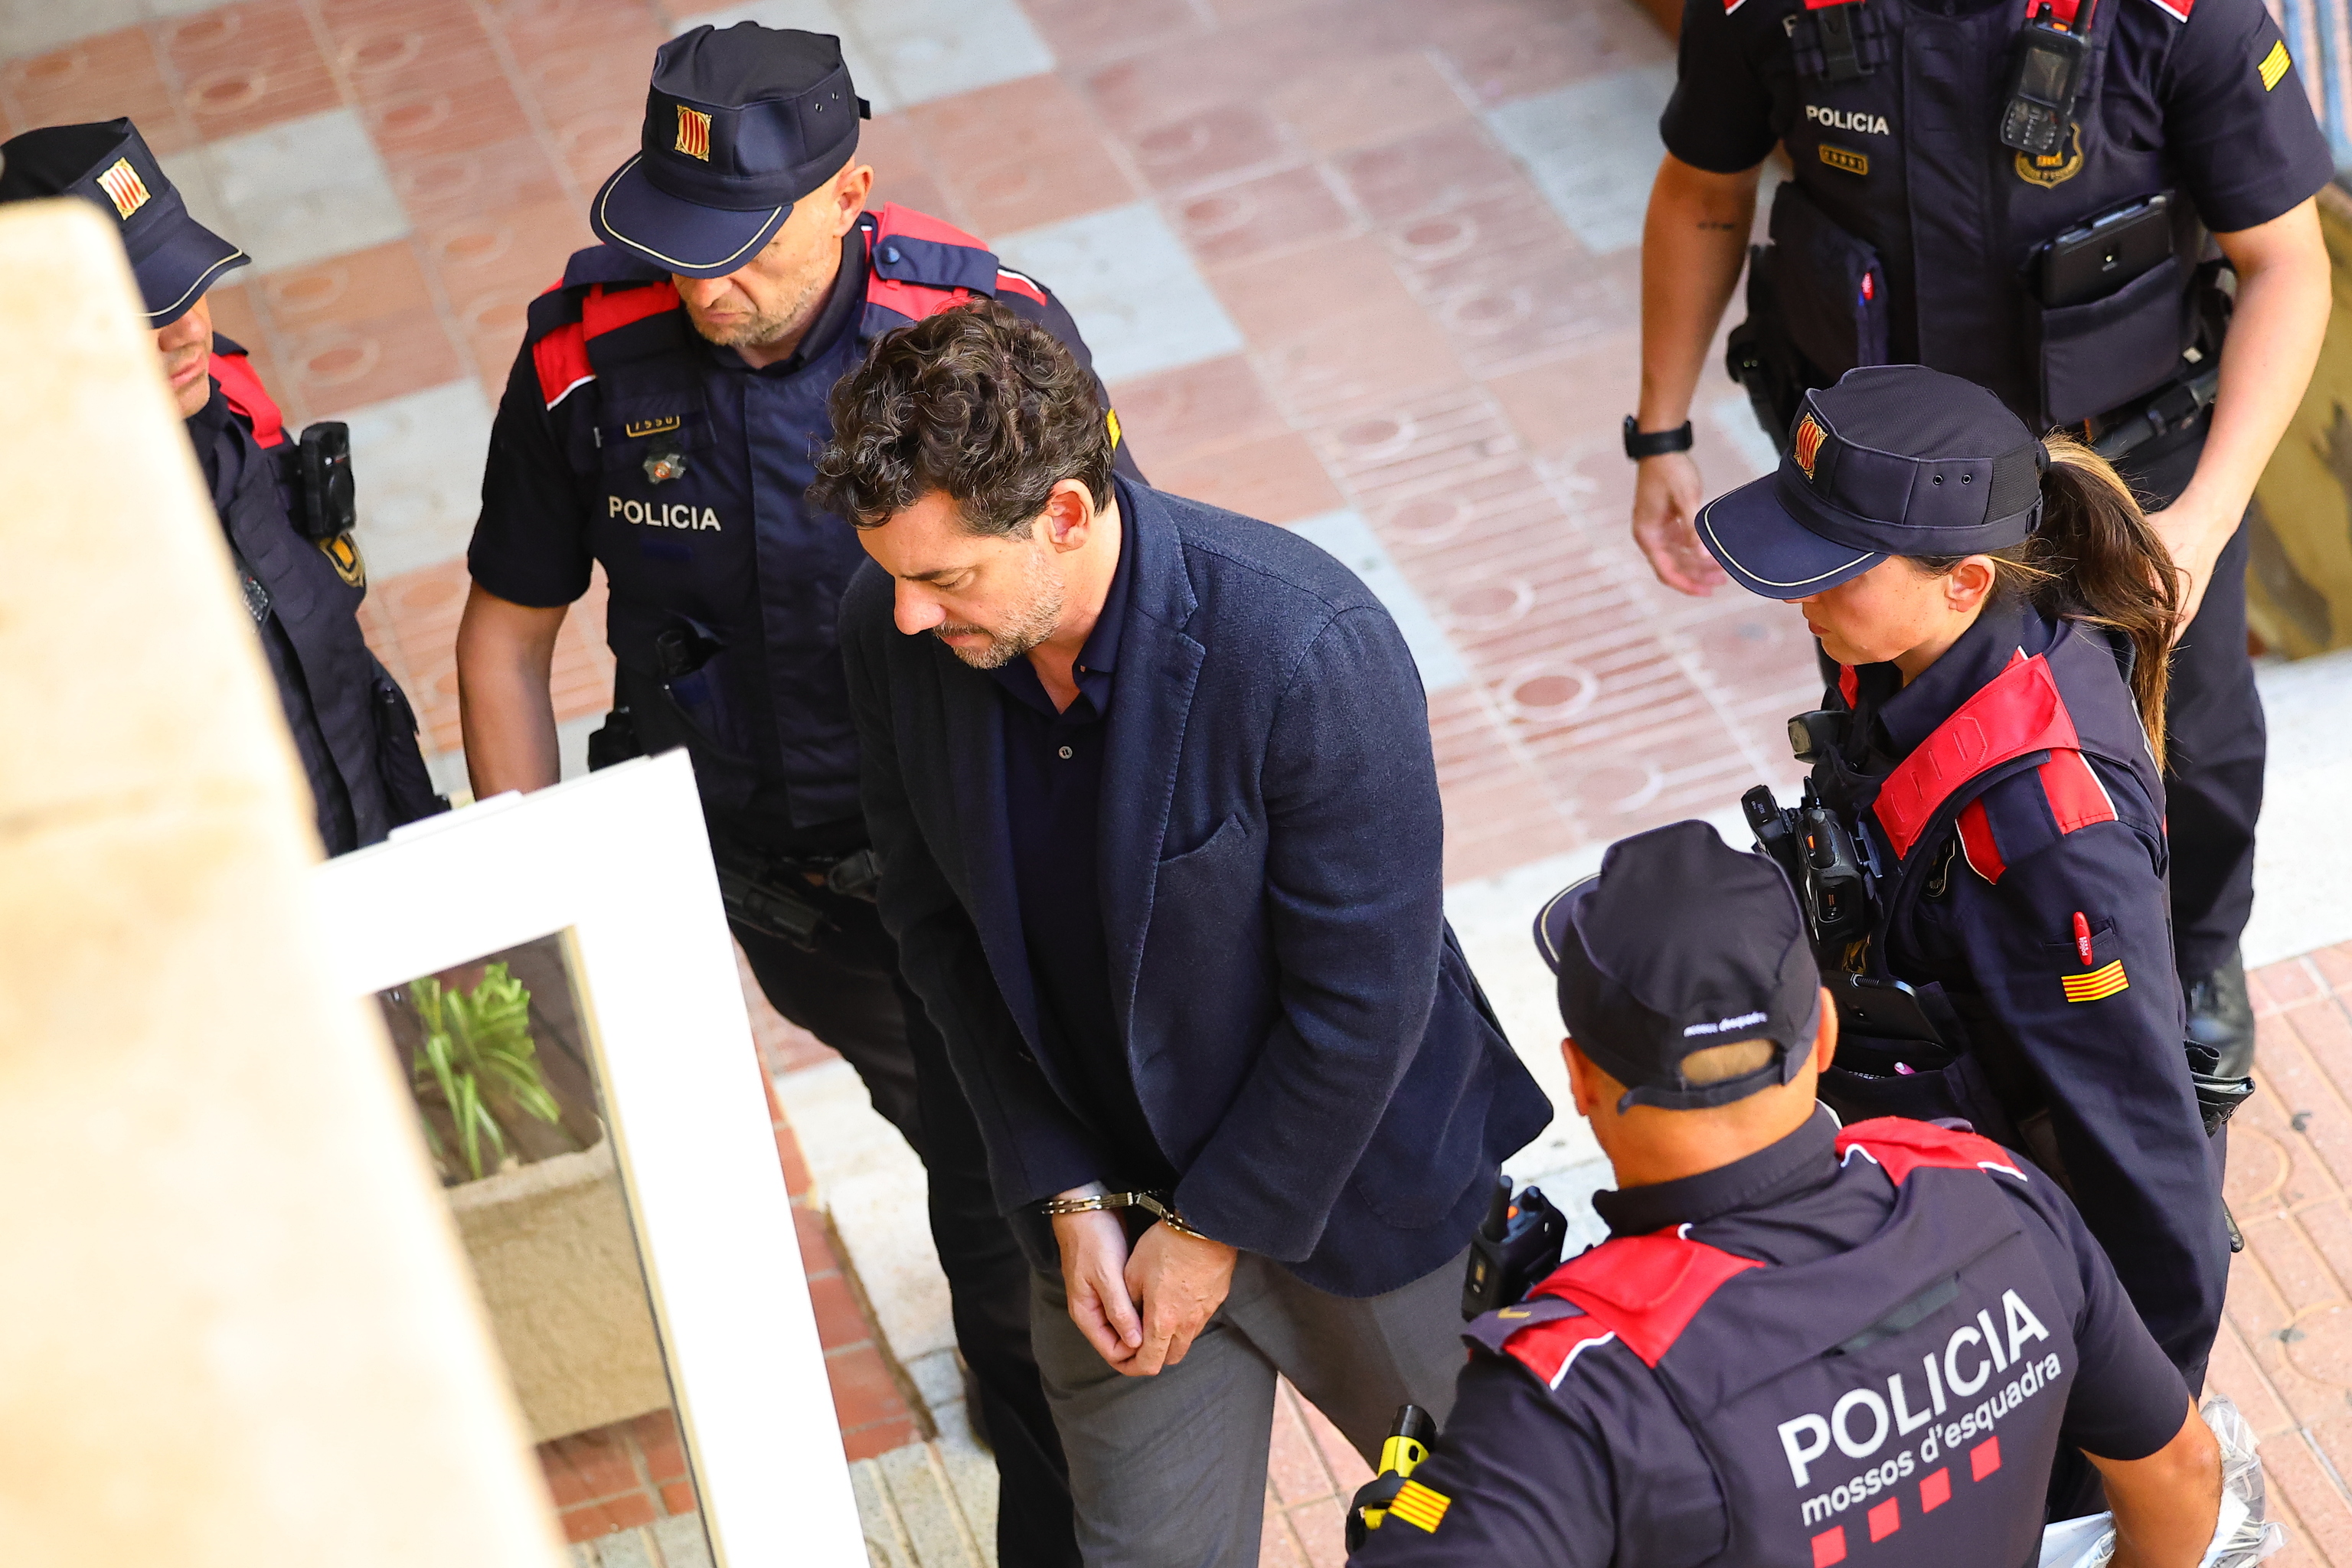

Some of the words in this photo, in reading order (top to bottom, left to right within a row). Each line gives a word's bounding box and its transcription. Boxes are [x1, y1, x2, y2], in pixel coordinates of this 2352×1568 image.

[1805, 105, 1890, 136] POLICIA
[609, 495, 721, 532] POLICIA
[1777, 1289, 2050, 1488] POLICIA
[1801, 1451, 1914, 1527] mossos
[1920, 1352, 2062, 1463] d'esquadra
